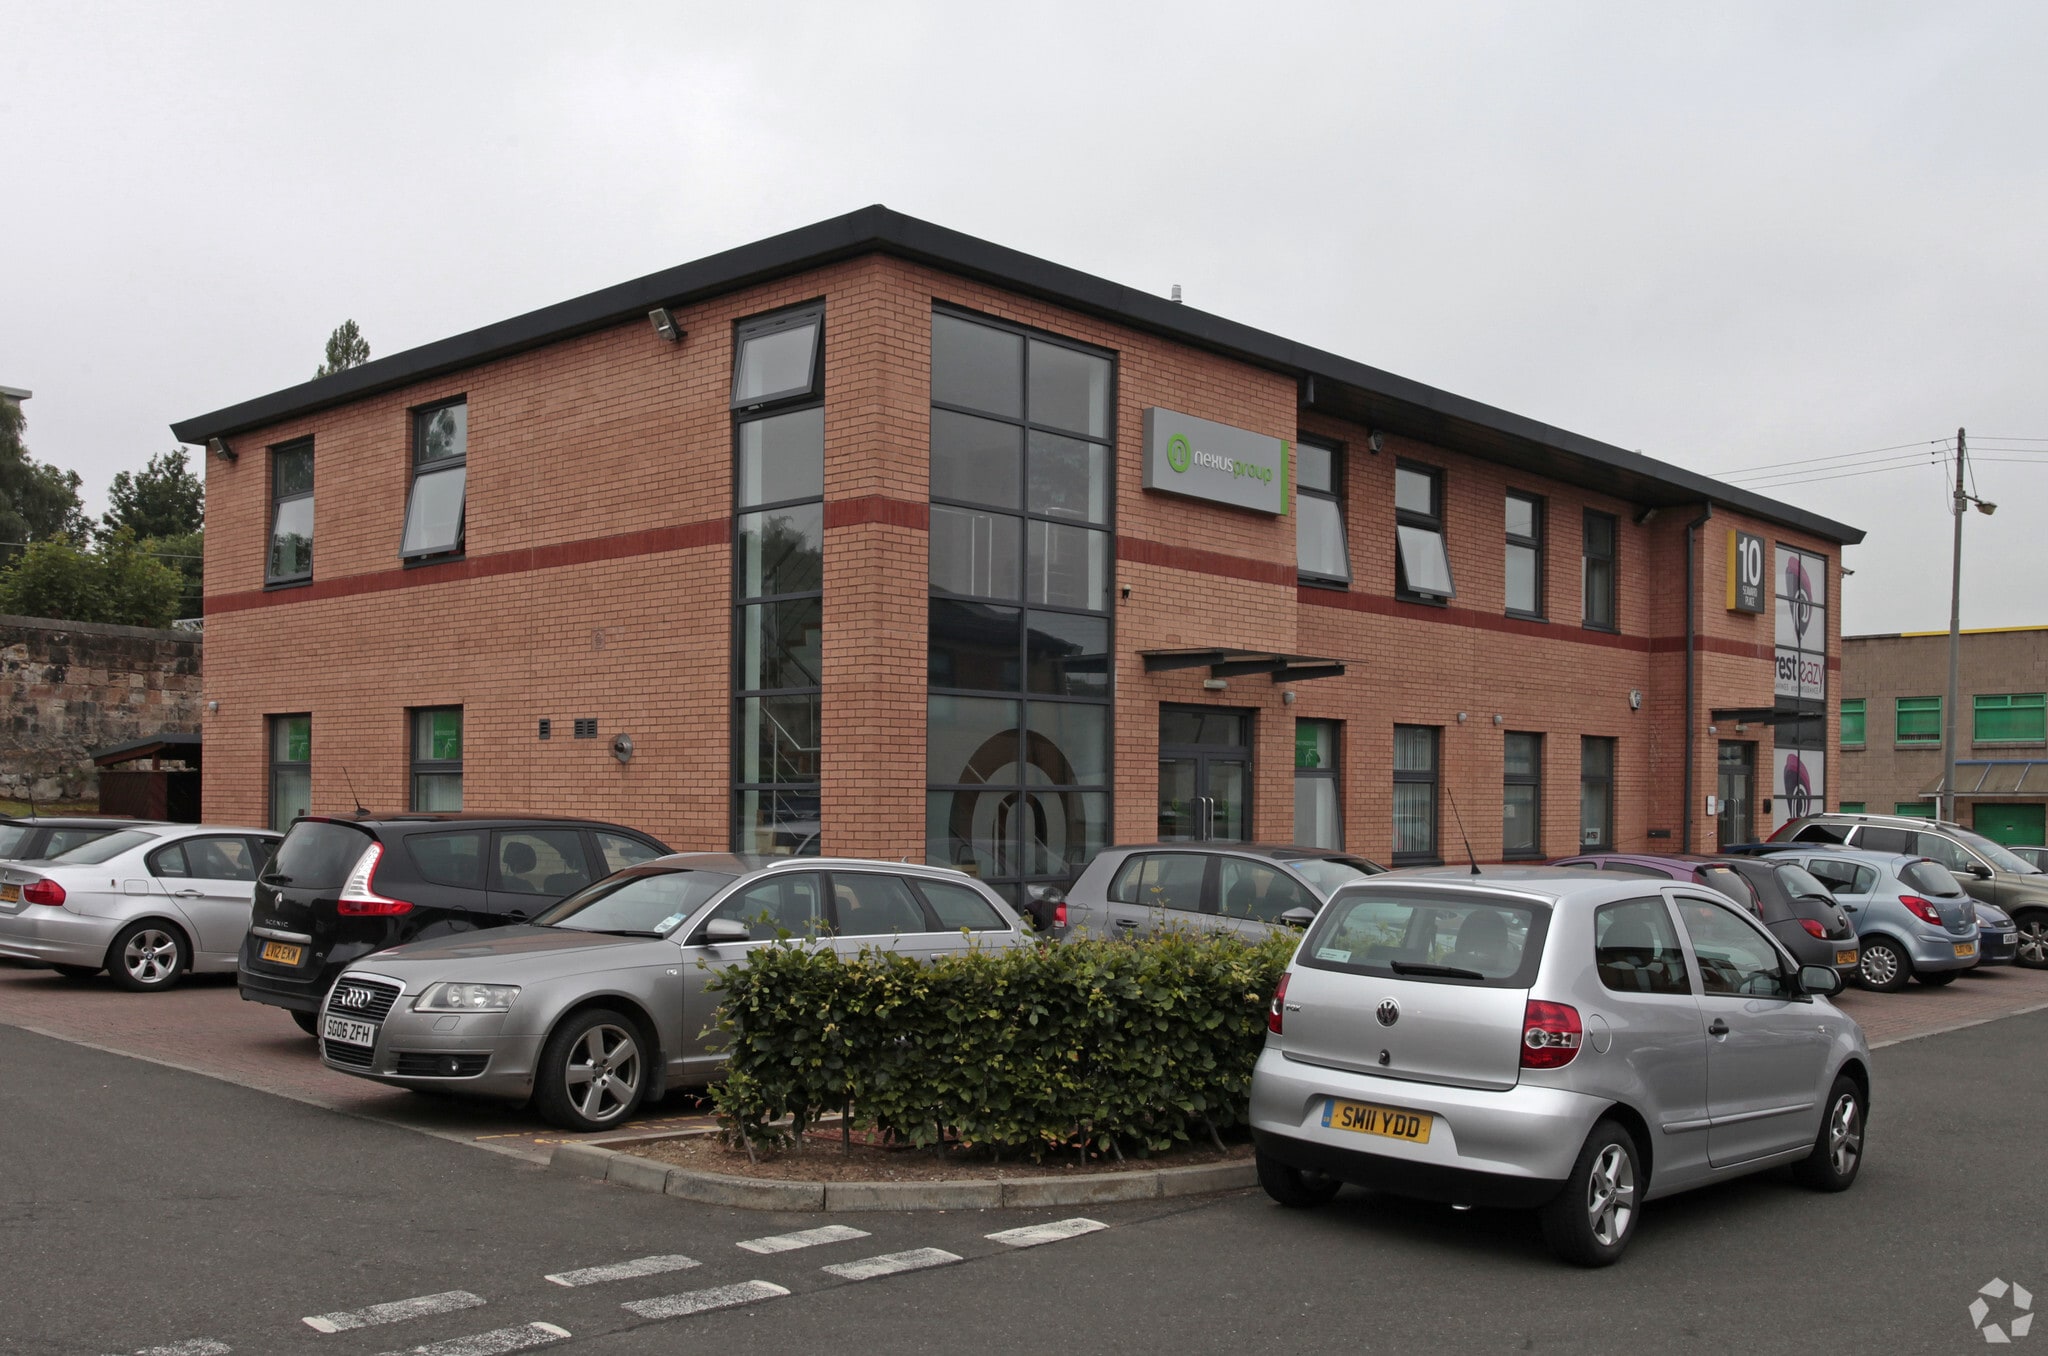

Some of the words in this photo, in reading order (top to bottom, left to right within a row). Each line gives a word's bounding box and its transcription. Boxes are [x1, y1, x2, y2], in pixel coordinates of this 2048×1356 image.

[1739, 537, 1761, 586] 10
[327, 1019, 348, 1039] SG06
[349, 1023, 371, 1043] ZFH
[1341, 1106, 1377, 1131] SM11
[1383, 1111, 1420, 1138] YDD
